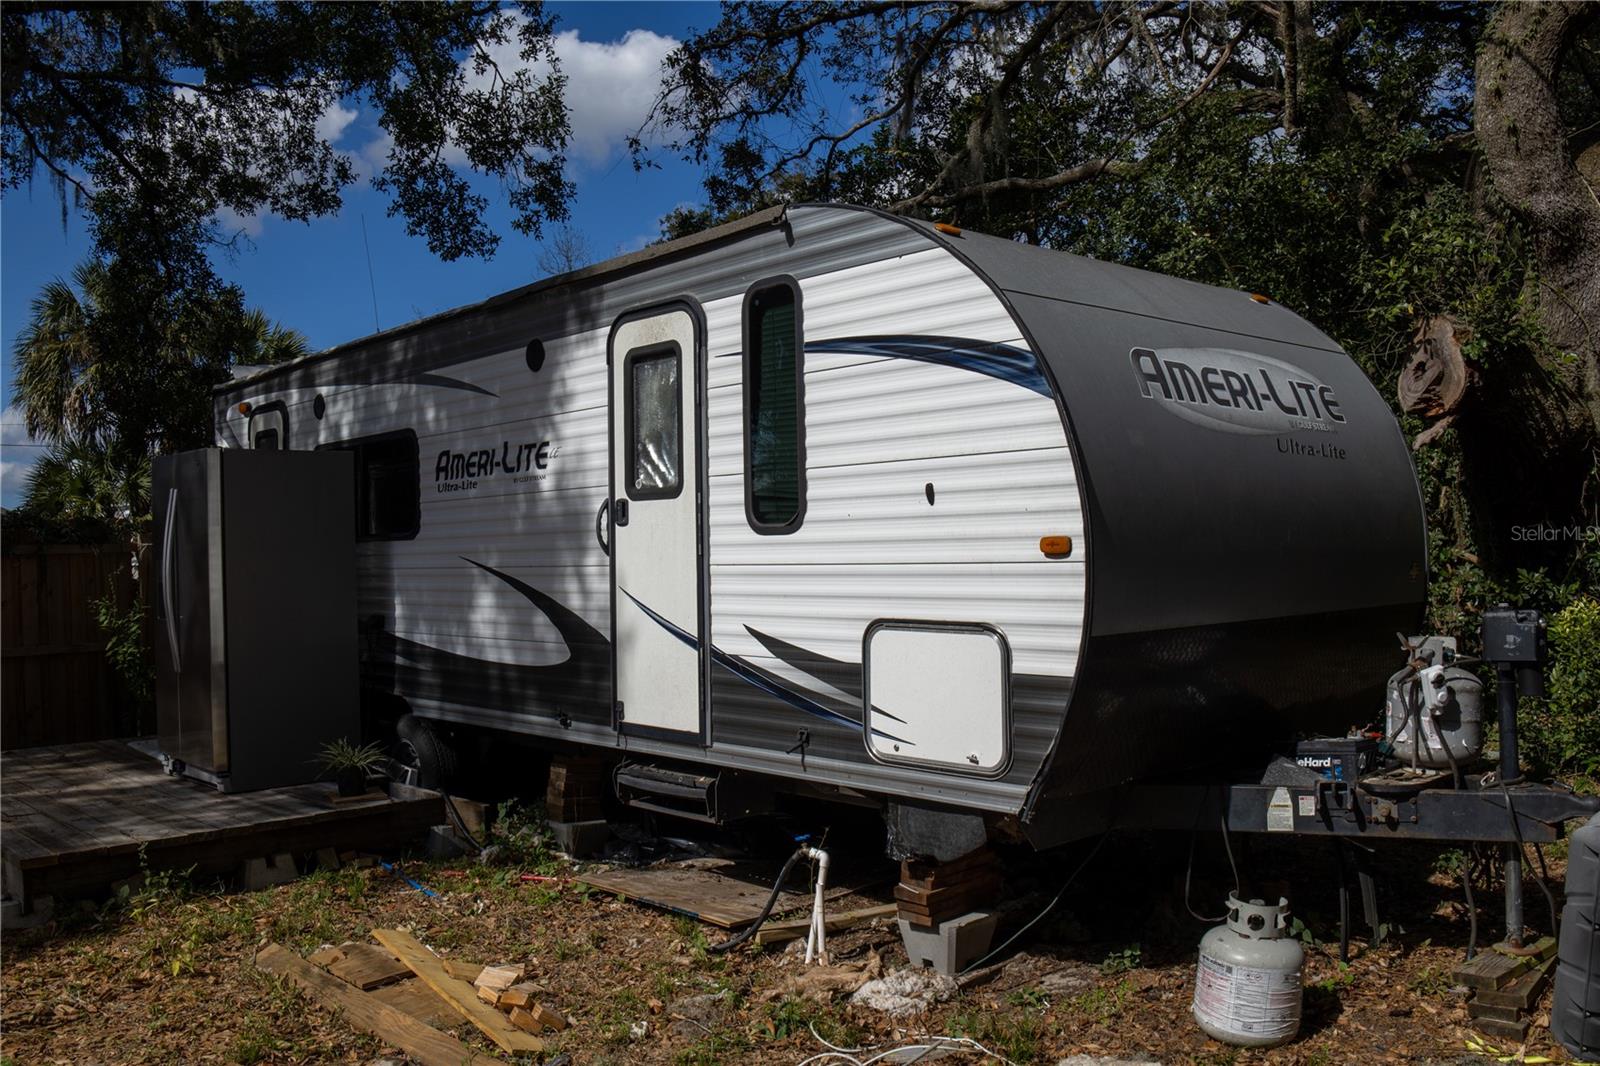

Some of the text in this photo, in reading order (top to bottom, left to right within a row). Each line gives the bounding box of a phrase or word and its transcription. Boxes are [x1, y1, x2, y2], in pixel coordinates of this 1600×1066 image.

[1129, 346, 1346, 424] AMERI-LITE
[435, 441, 549, 482] AMERI-LITE
[1276, 437, 1346, 460] Ultra-Lite
[437, 480, 478, 493] Ultra-Lite
